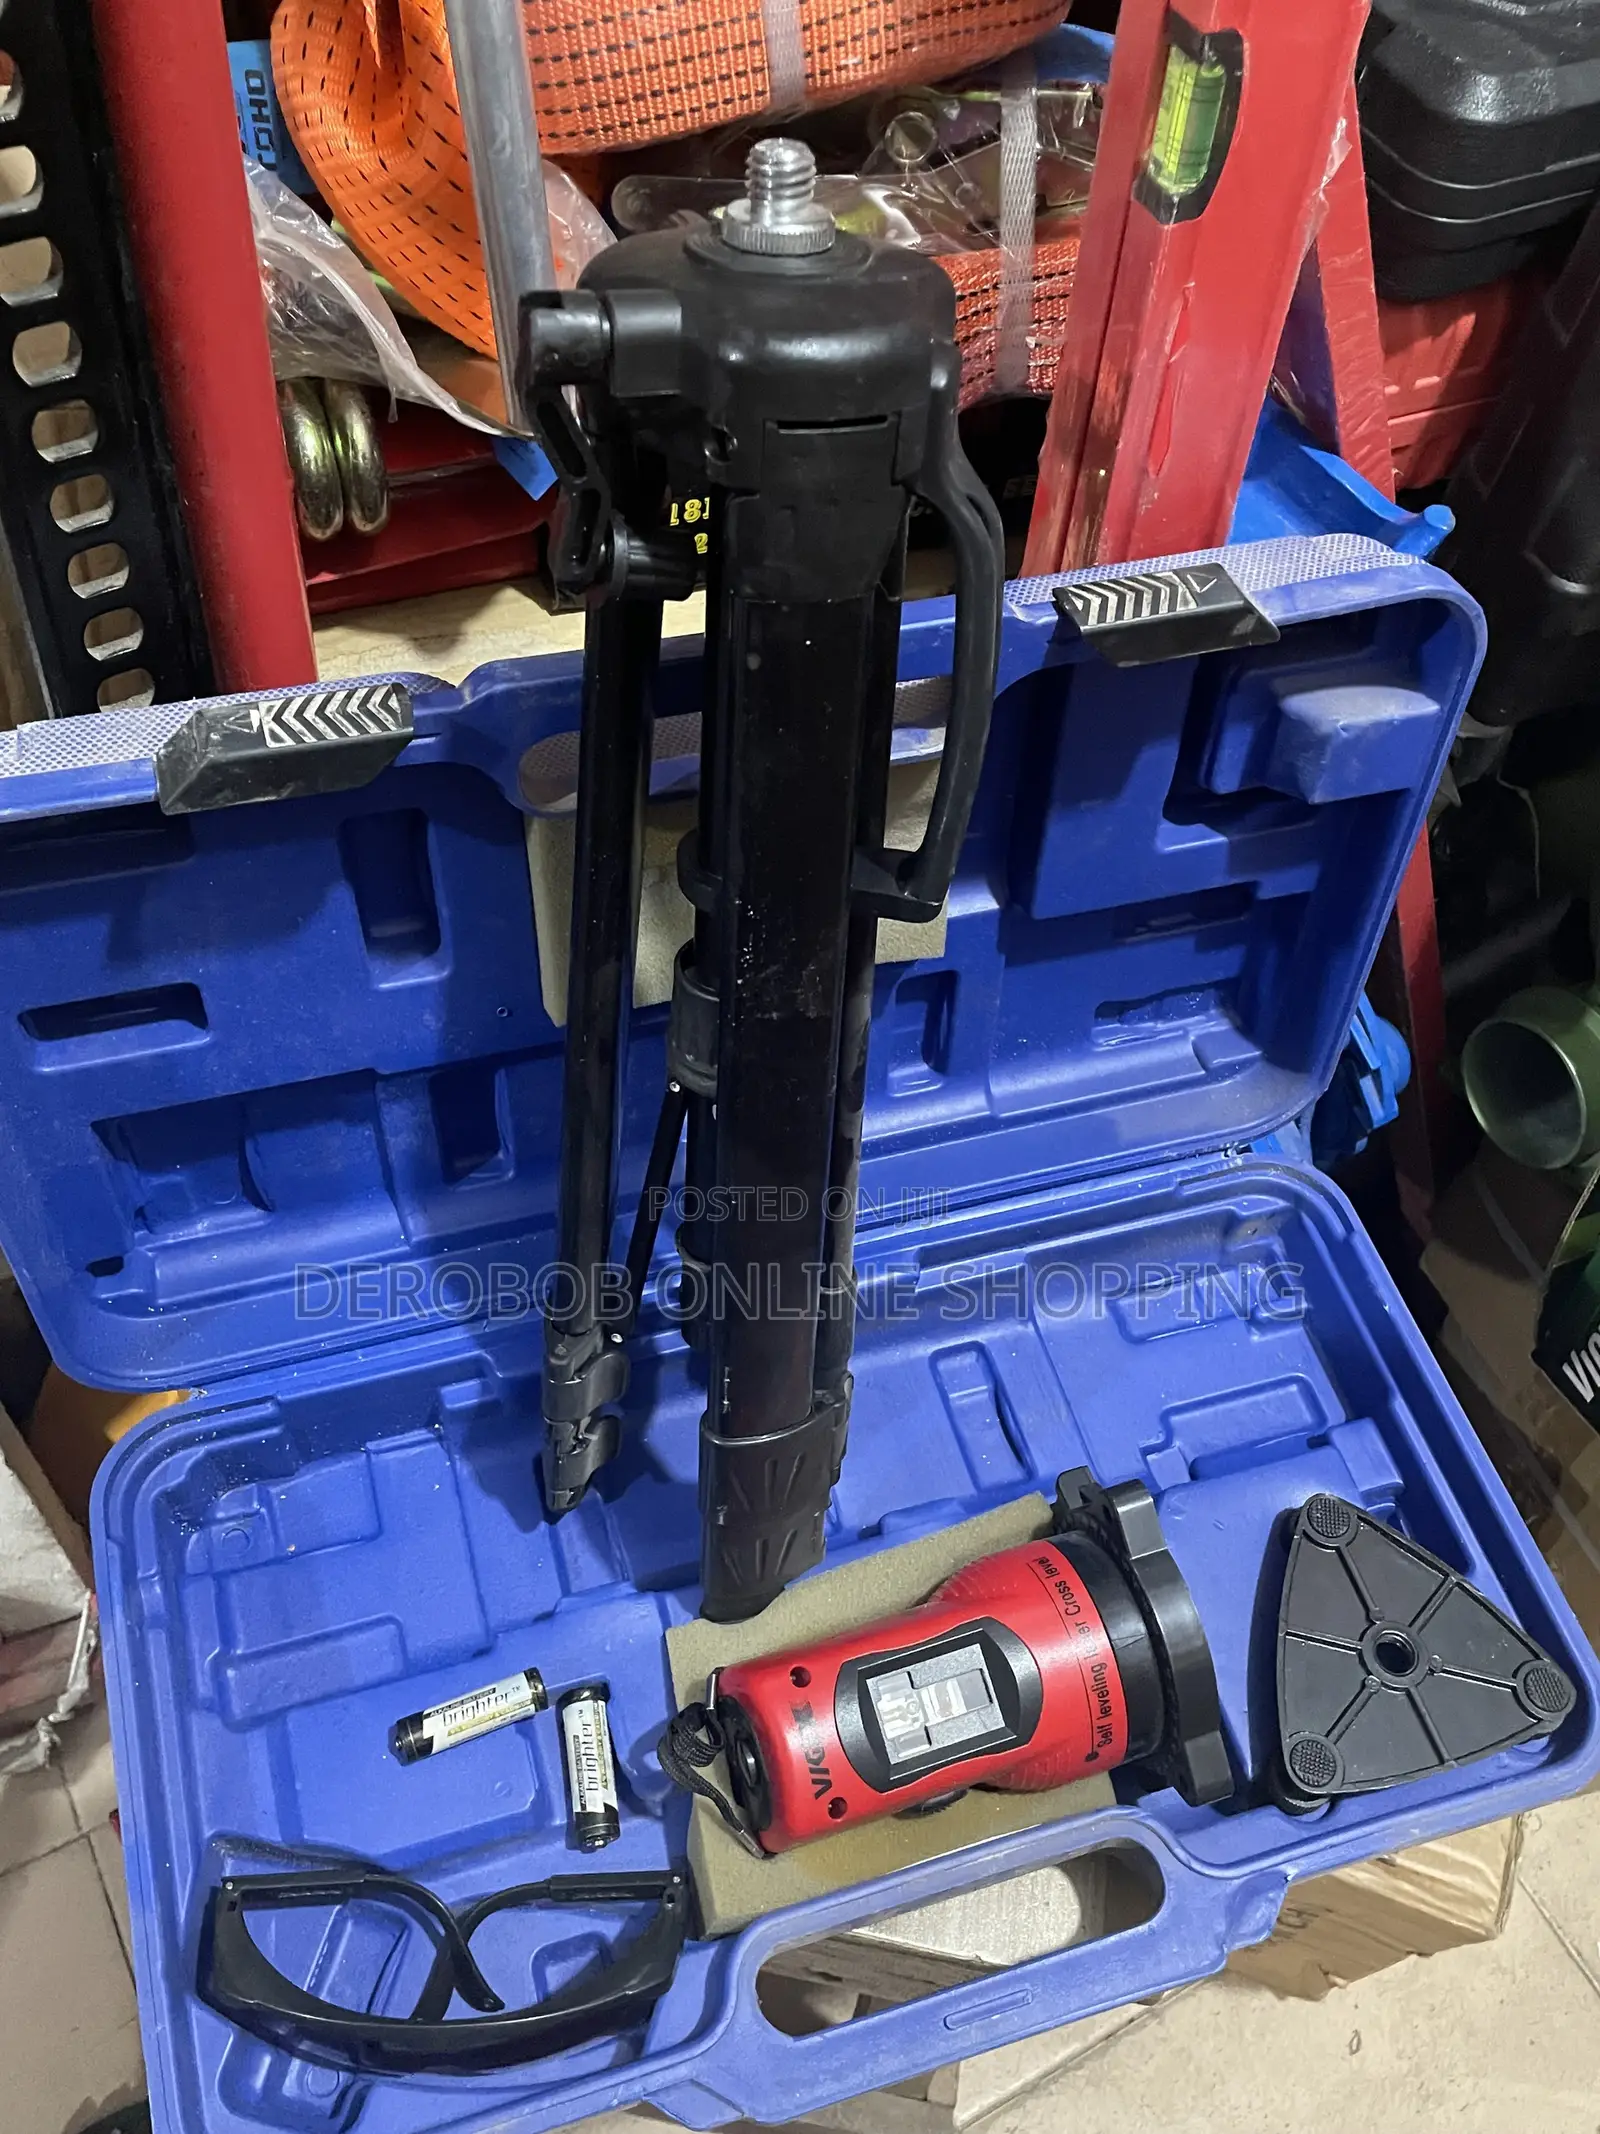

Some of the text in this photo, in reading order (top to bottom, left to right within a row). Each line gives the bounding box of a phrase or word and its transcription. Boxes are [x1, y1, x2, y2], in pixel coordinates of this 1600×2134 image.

[1033, 1556, 1060, 1580] level
[1055, 1580, 1081, 1616] Cross
[442, 1691, 511, 1727] brighter
[1091, 1662, 1113, 1721] leveling
[1096, 1721, 1113, 1749] Self
[582, 1723, 599, 1791] brighter
